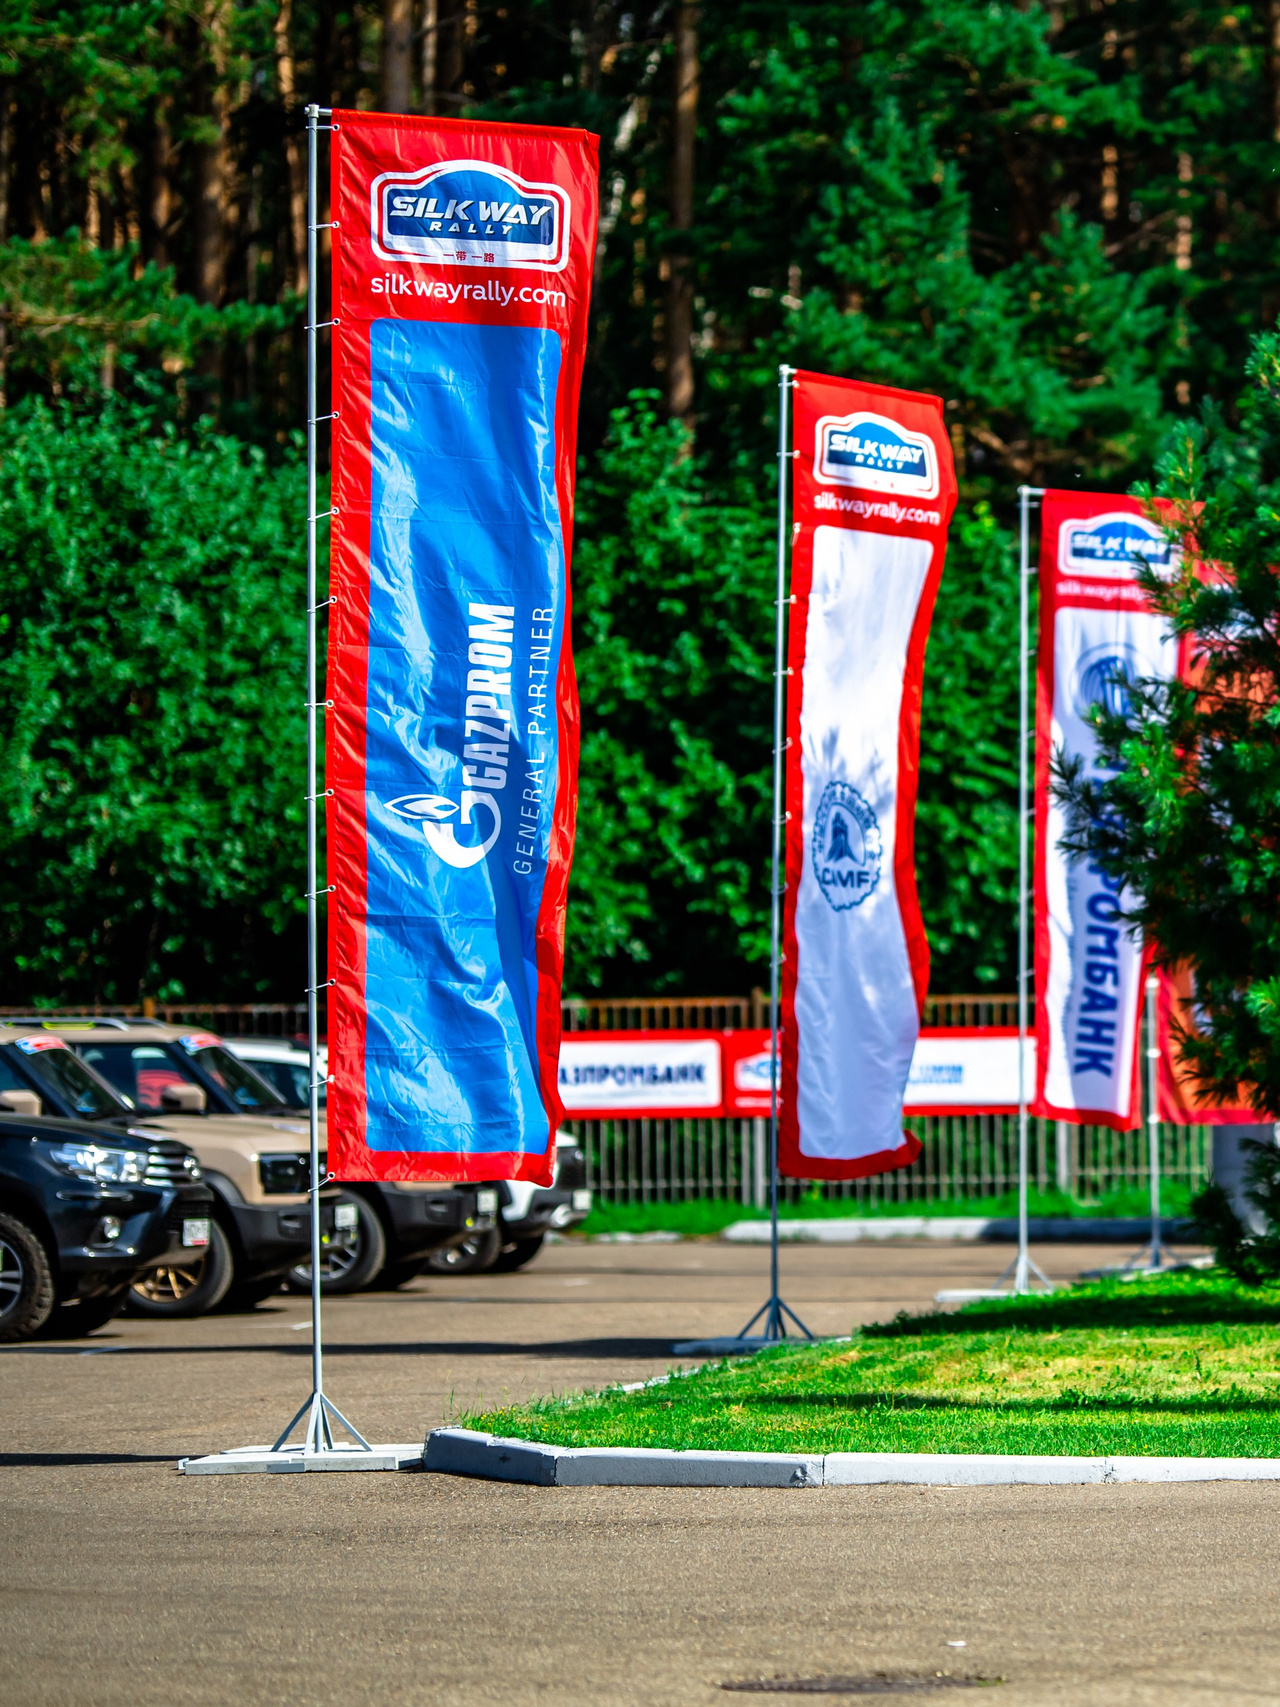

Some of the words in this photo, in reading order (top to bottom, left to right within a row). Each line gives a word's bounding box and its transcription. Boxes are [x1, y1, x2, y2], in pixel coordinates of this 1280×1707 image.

[389, 196, 474, 221] SILK
[479, 201, 552, 225] WAY
[429, 221, 513, 235] RALLY
[370, 272, 567, 308] silkwayrally.com
[829, 434, 878, 457] SILK
[879, 443, 923, 464] WAY
[813, 491, 940, 526] silkwayrally.com
[527, 607, 553, 735] PARTNER
[462, 602, 515, 790] GAZPROM
[513, 751, 545, 875] GENERAL
[559, 1063, 705, 1086] АЗПРОМБАНК
